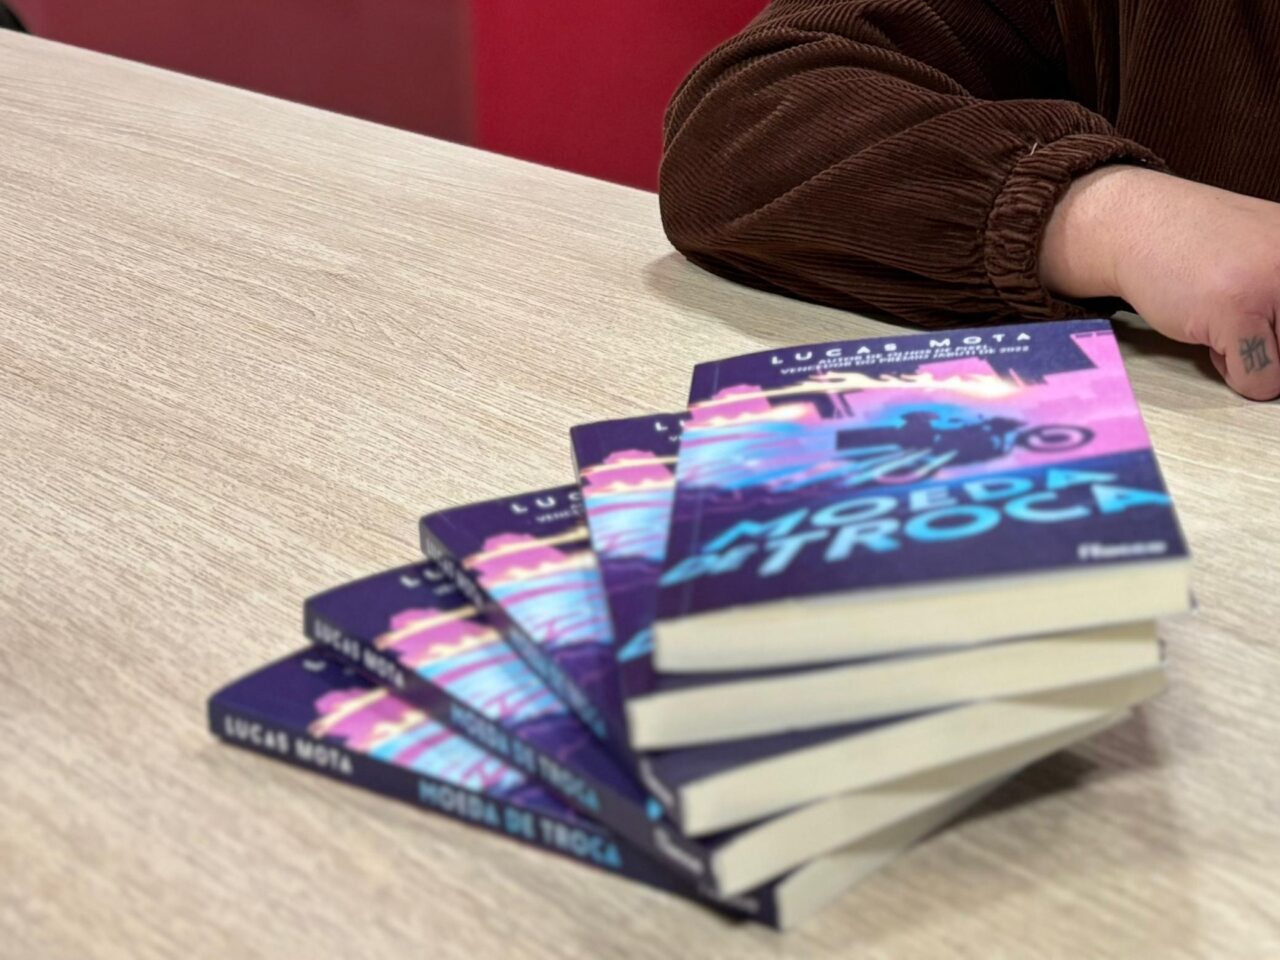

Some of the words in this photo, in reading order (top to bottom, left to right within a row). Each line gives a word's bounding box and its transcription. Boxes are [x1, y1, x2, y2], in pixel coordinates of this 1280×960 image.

[771, 343, 897, 364] LUCAS
[929, 332, 1031, 348] MOTA
[702, 467, 1117, 554] MOEDA
[757, 485, 1172, 577] TROCA
[224, 714, 290, 753] LUCAS
[294, 737, 354, 775] MOTA
[418, 777, 500, 827] MOEDA
